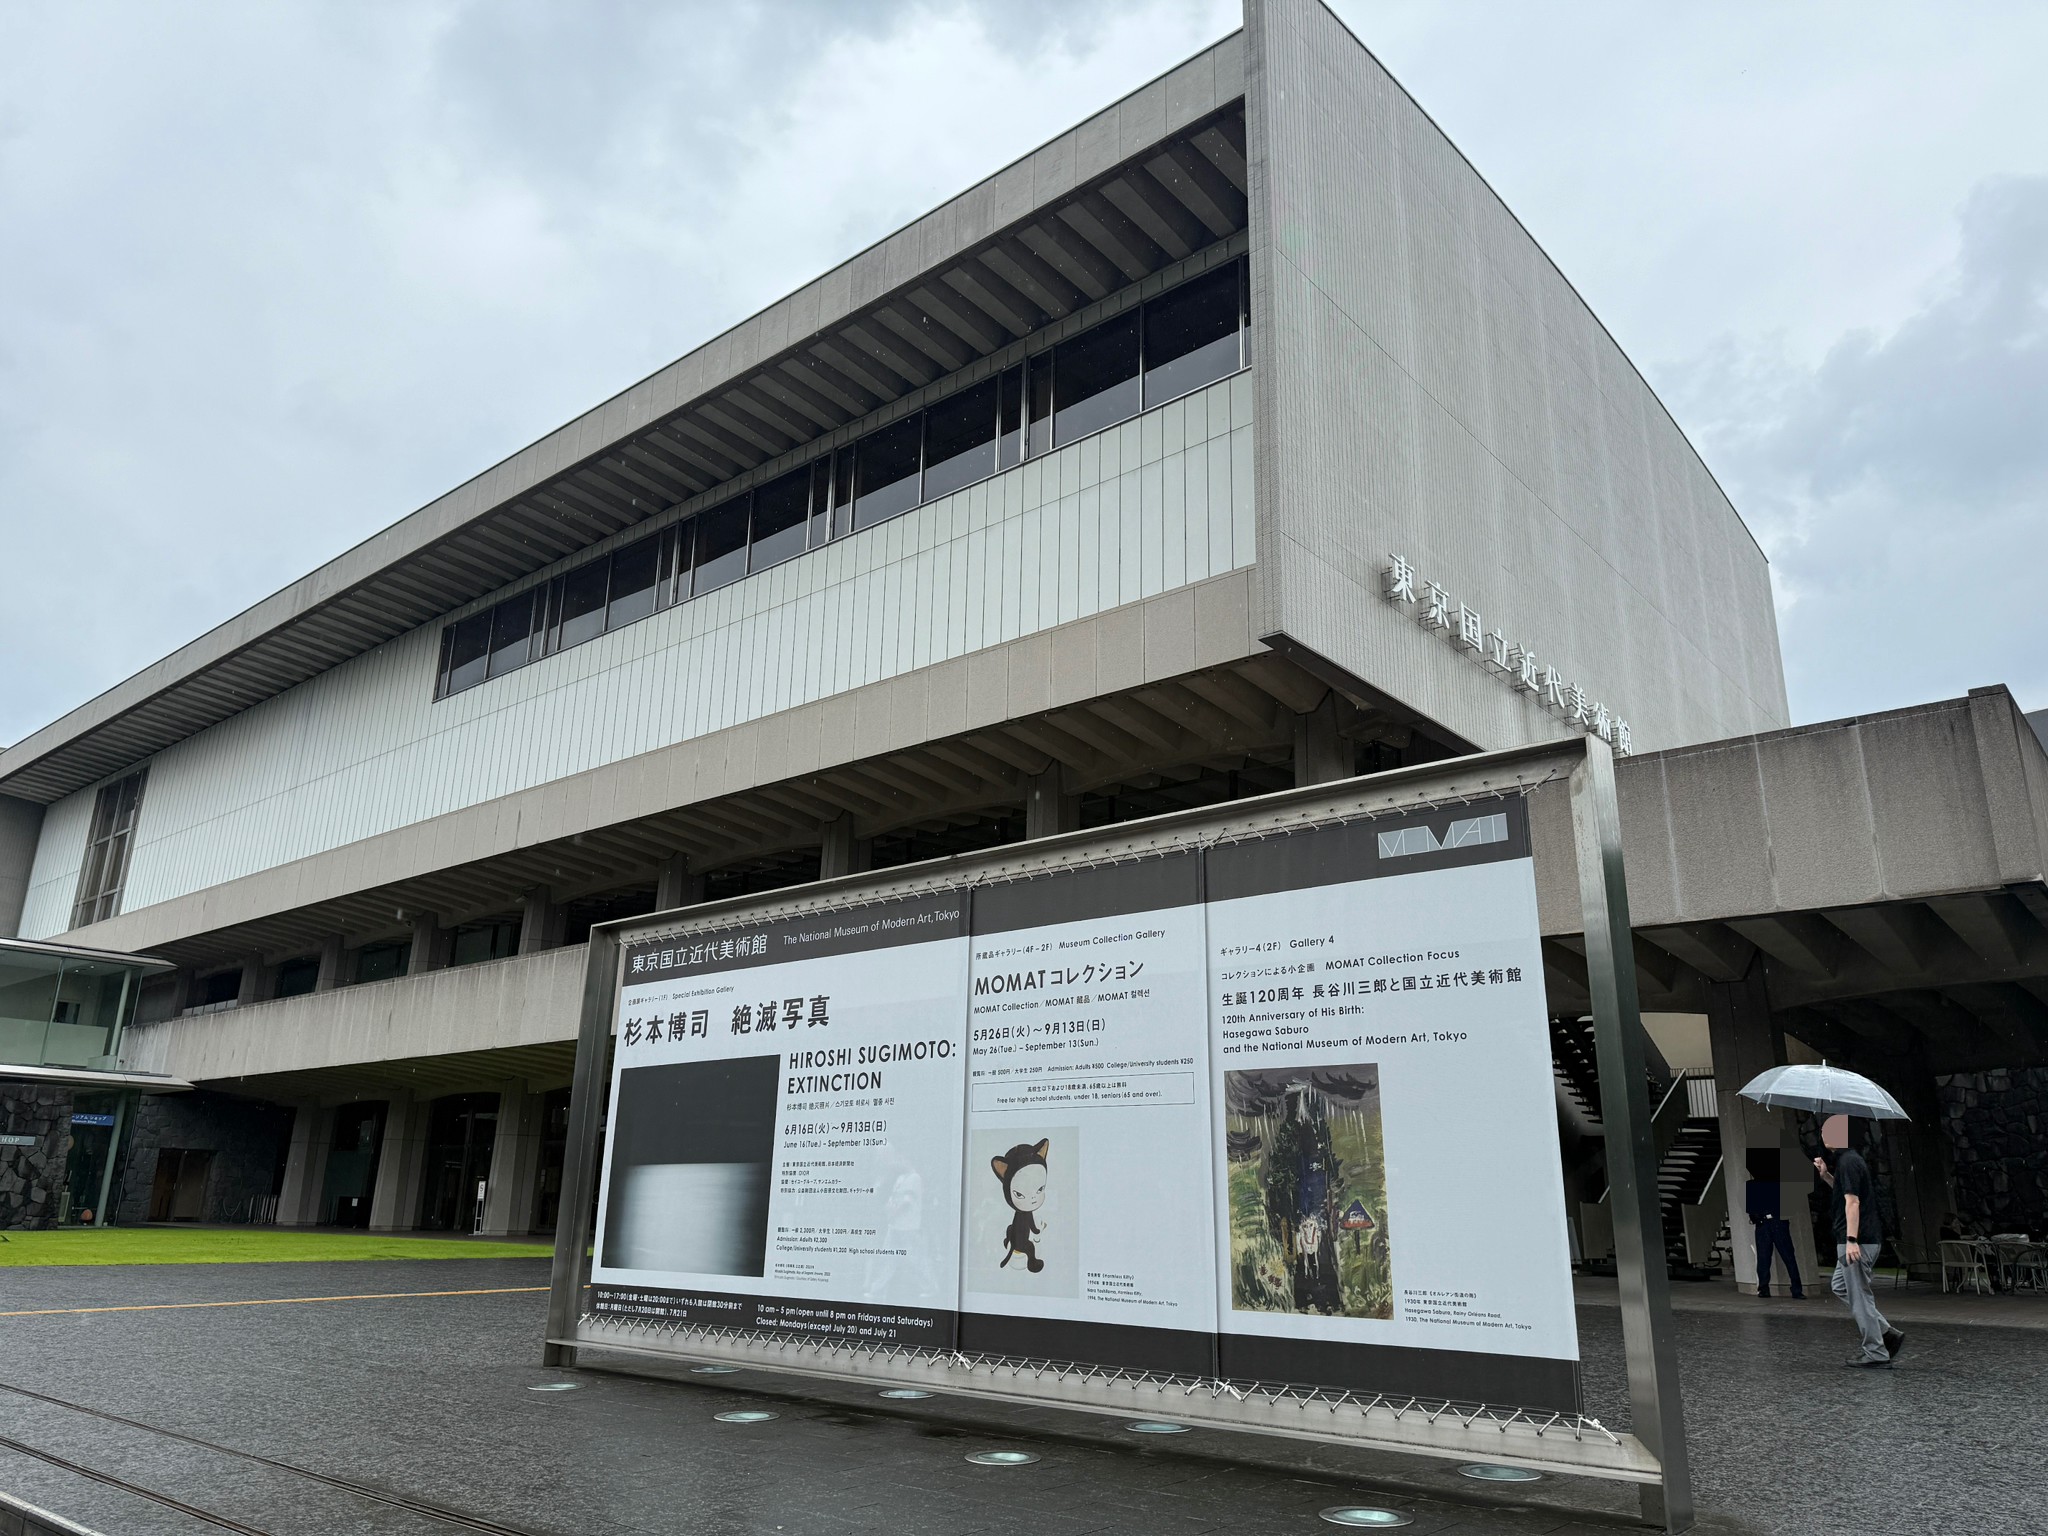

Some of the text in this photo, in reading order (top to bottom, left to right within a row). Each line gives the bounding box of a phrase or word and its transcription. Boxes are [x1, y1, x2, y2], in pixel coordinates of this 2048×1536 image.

[1388, 552, 1633, 757] 東京国立近代美術館
[784, 935, 797, 945] The
[799, 928, 831, 943] National
[834, 924, 868, 937] Museum
[871, 921, 879, 930] of
[882, 916, 915, 929] Modern
[1059, 928, 1165, 949] Museum Collection Gallery
[1289, 935, 1335, 950] Gallery 4
[631, 933, 768, 974] 東京国立近代美術館
[1325, 949, 1460, 971] MOMAT Collection Focus
[1221, 962, 1315, 981] コレクションによる小企画
[673, 991, 690, 1000] Special
[691, 988, 715, 997] Exhibition
[1222, 967, 1522, 1007] 生誕120周年 長谷川三郎と国立近代美術館
[974, 1004, 1000, 1014] MOMAT
[1222, 1004, 1364, 1024] 120th Anniversary of His Birth:
[624, 994, 830, 1047] 杉本博司 絶滅写真
[1223, 1024, 1309, 1040] Hasegawa Saburo
[1223, 1031, 1467, 1054] and the National Museum of Modern Art, Tokyo
[789, 1039, 956, 1069] HIROSHI SUGIMOTO:
[973, 1046, 987, 1057] May
[1025, 1040, 1066, 1053] September
[788, 1071, 882, 1094] EXTINCTION
[1017, 1096, 1028, 1104] high
[828, 1139, 861, 1147] September
[757, 1304, 764, 1312] 10
[780, 1306, 784, 1314] 5
[816, 1308, 829, 1317] until
[830, 1310, 834, 1318] 8
[836, 1312, 846, 1320] pm
[857, 1312, 881, 1323] Fridays
[897, 1316, 933, 1327] Saturdays)
[1405, 1308, 1431, 1316] Hasegawa
[756, 1317, 778, 1326] Closed:
[833, 1324, 846, 1334] July
[847, 1325, 857, 1334] 20)
[859, 1327, 871, 1335] and
[873, 1327, 887, 1338] July
[889, 1329, 897, 1337] 21
